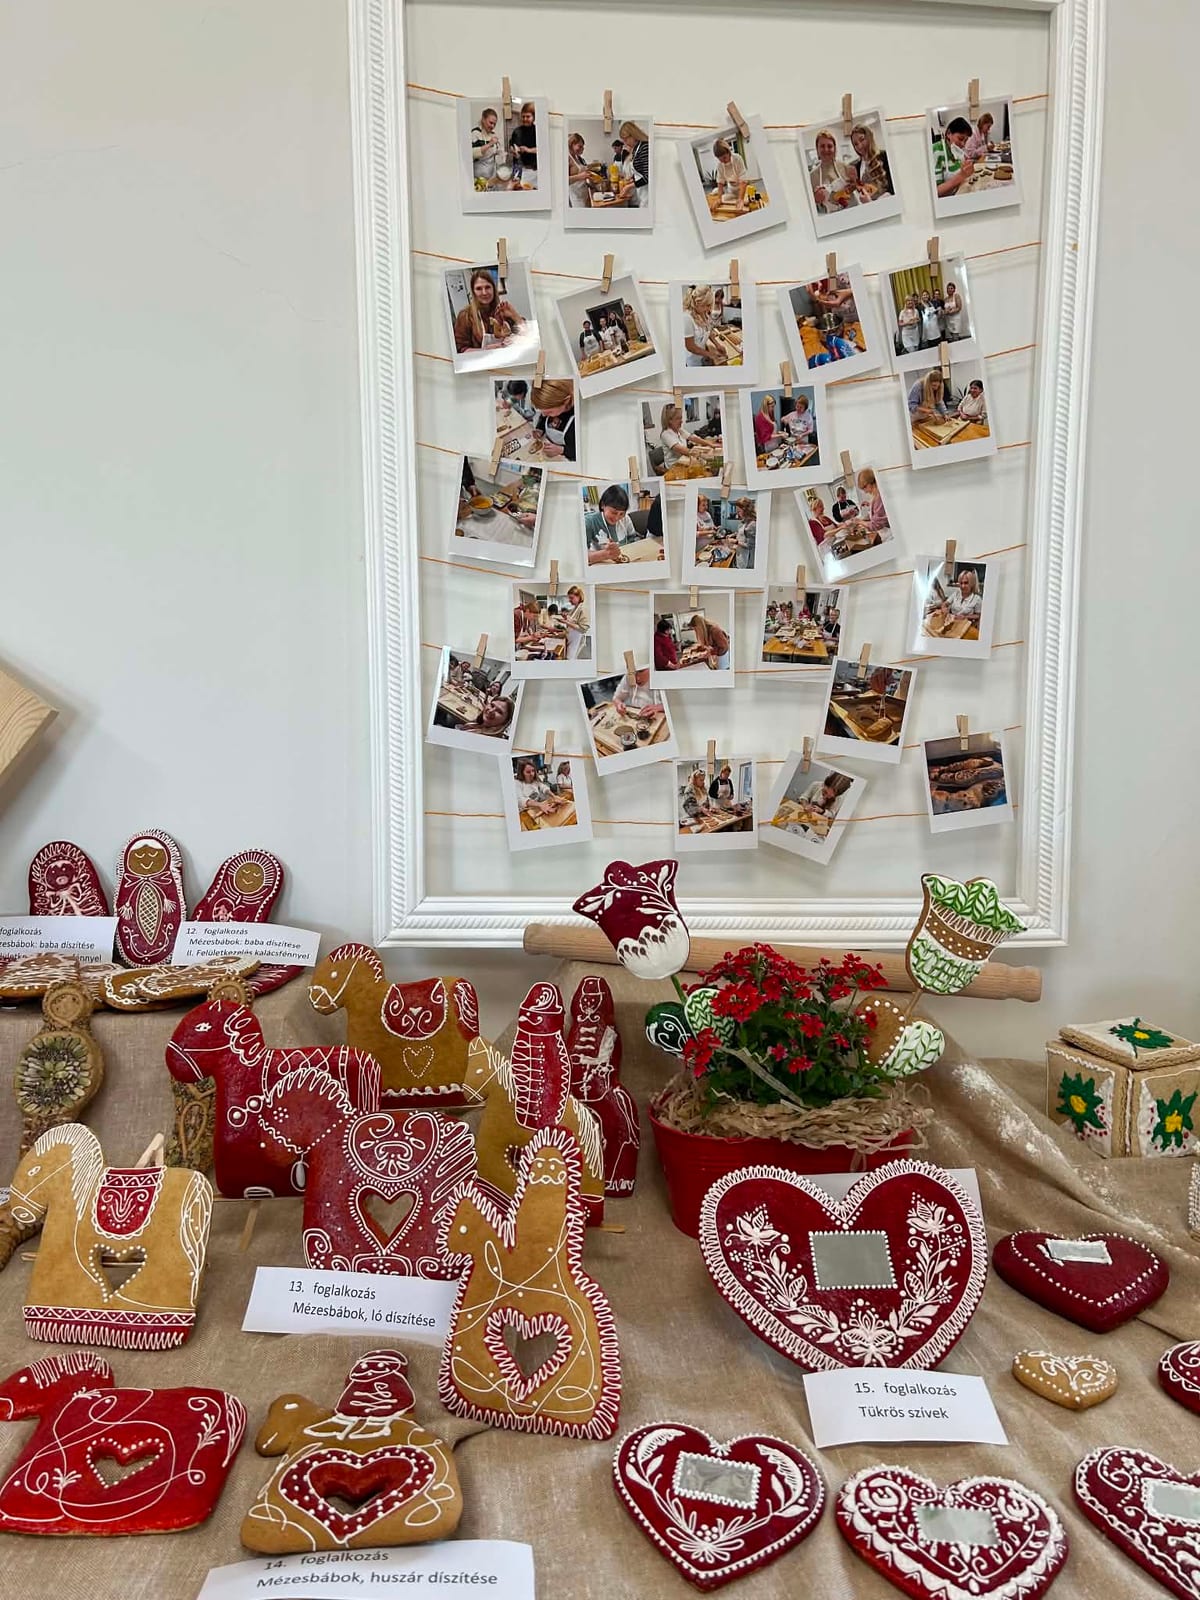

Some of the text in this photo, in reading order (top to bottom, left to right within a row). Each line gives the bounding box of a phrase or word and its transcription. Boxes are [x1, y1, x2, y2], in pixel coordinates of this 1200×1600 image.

[204, 928, 249, 936] foglalkozás
[40, 941, 59, 949] baba
[61, 942, 95, 950] díszítése
[266, 940, 302, 949] díszítése
[289, 1281, 376, 1300] 13. foglalkozás
[292, 1301, 436, 1327] Mézesbábok, ló díszítése
[854, 1382, 957, 1397] 15. foglalkozás
[858, 1406, 949, 1420] Tükrös szívek
[264, 1550, 390, 1571] 14. foglalkozás
[256, 1571, 498, 1588] Mézesbábok, huszár díszítése
